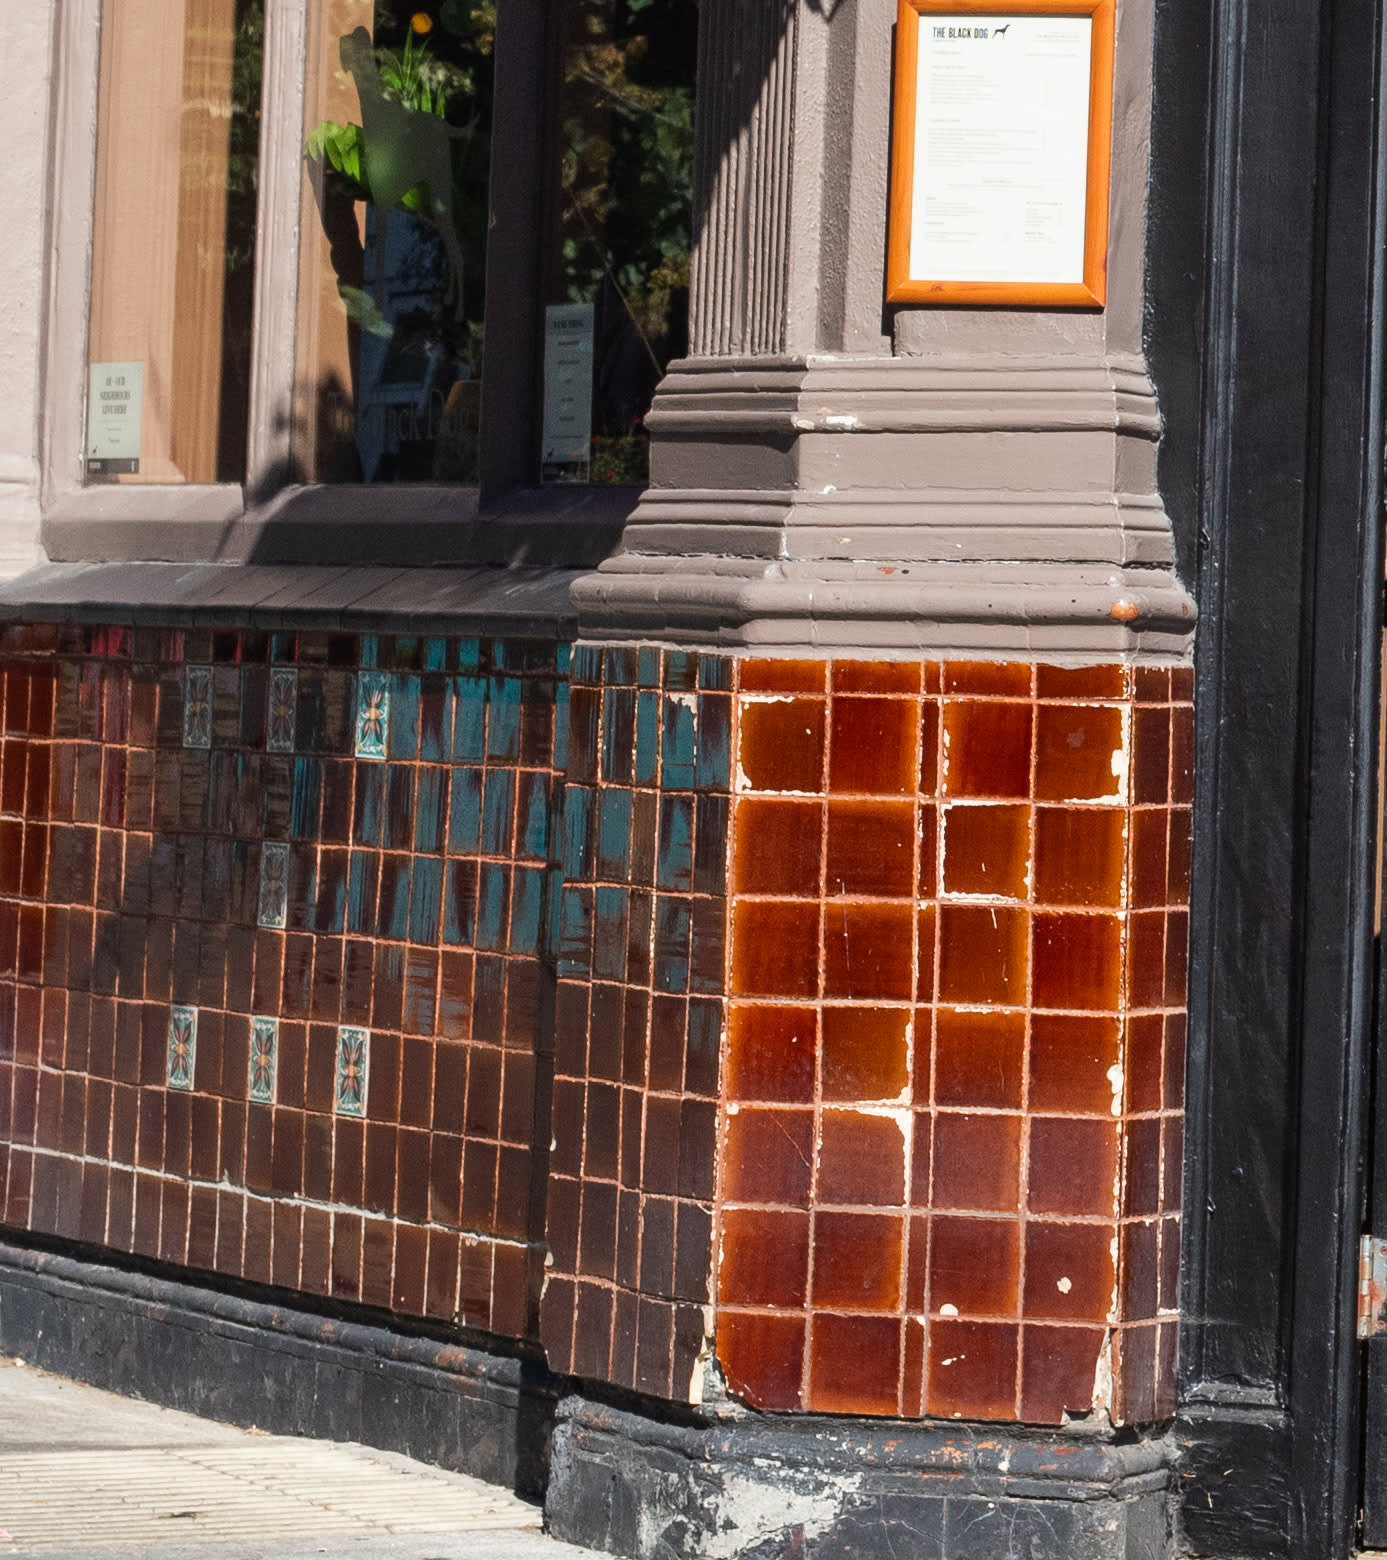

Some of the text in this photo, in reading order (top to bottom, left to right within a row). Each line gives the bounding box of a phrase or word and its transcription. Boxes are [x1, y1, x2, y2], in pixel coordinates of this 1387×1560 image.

[933, 26, 989, 39] THE BLACK DOG
